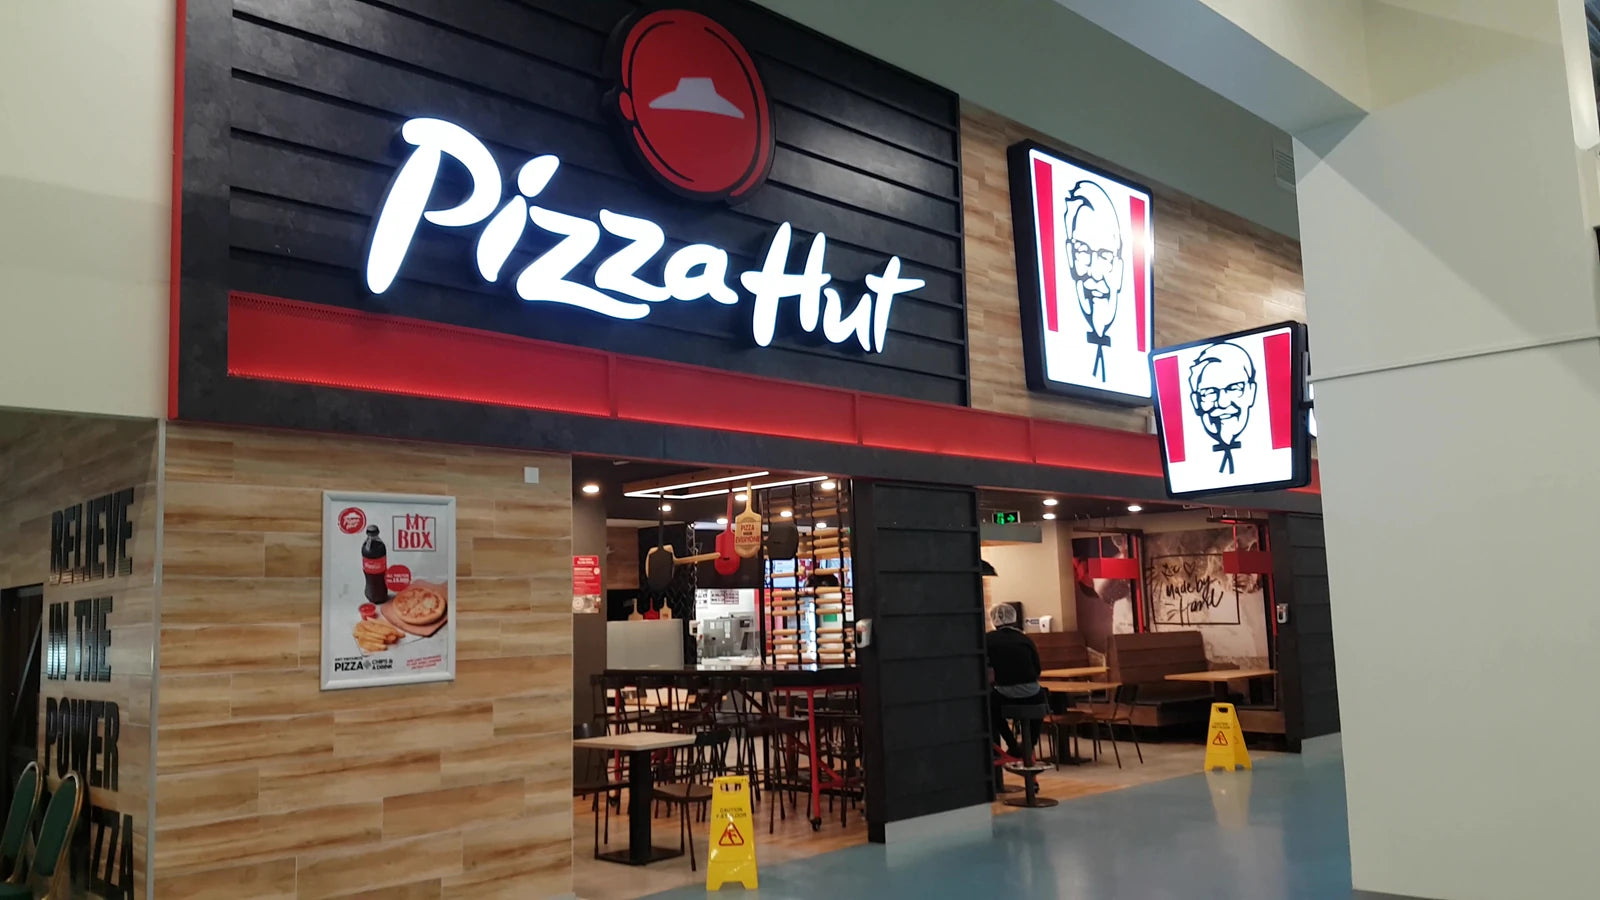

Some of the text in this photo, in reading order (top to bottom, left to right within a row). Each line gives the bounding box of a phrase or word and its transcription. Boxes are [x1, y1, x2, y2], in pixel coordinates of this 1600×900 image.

[366, 117, 926, 354] Pizza Hut
[397, 529, 433, 549] BOX
[406, 513, 431, 530] MY
[48, 596, 114, 682] IN THE
[334, 661, 364, 672] PIZZA
[45, 697, 120, 792] POWER
